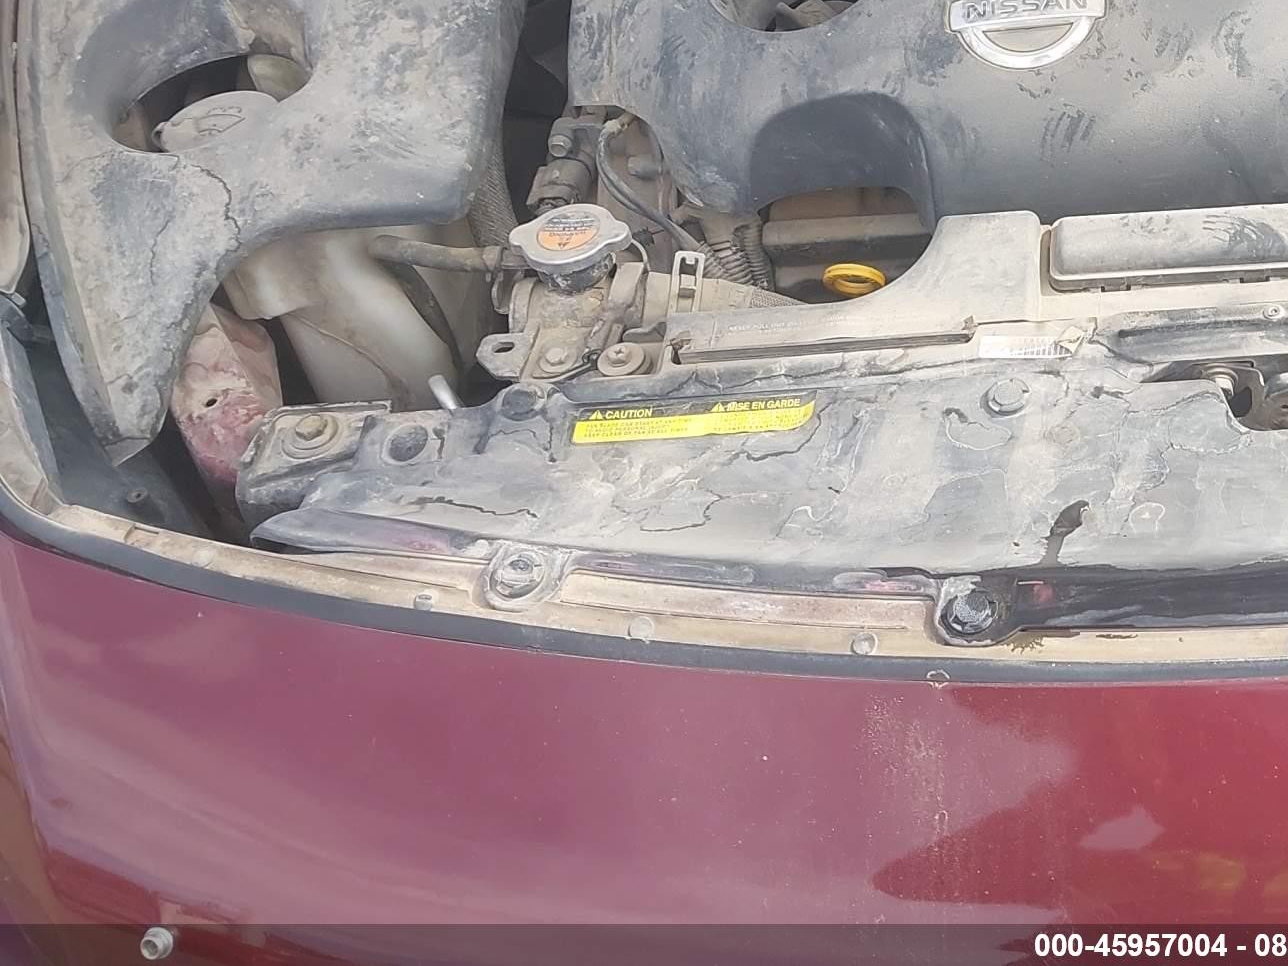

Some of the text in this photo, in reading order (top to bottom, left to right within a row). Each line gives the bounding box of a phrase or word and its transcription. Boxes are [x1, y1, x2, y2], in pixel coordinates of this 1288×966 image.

[726, 398, 801, 411] MISE EN GARDE
[605, 409, 653, 419] CAUTION
